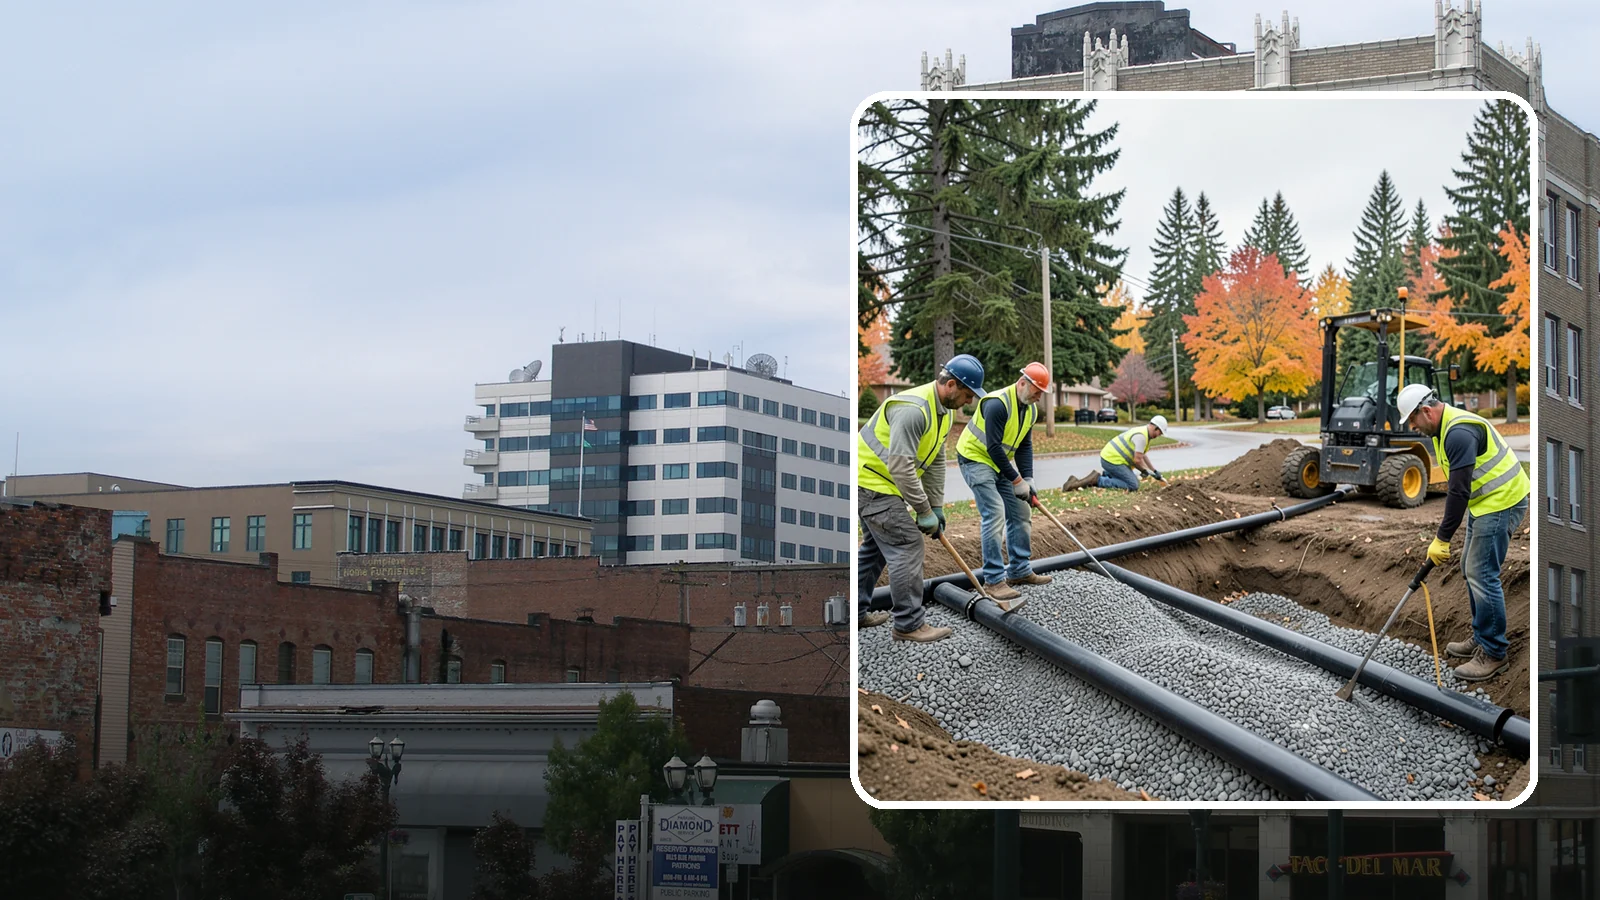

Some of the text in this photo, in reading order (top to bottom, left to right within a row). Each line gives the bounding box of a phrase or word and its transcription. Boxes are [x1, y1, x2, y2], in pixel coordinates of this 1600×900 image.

[343, 566, 426, 577] Home Furnishers
[660, 818, 713, 833] DIAMOND
[1022, 815, 1070, 828] BUILDING
[656, 845, 716, 854] RESERVED PARKING
[616, 825, 625, 894] PAY HERE
[628, 824, 637, 894] PAY HERE
[721, 851, 739, 862] Soup
[671, 862, 701, 870] PATRONS
[1290, 856, 1443, 877] TAC DEL MAR
[661, 888, 710, 898] PUBLIC PARKING
